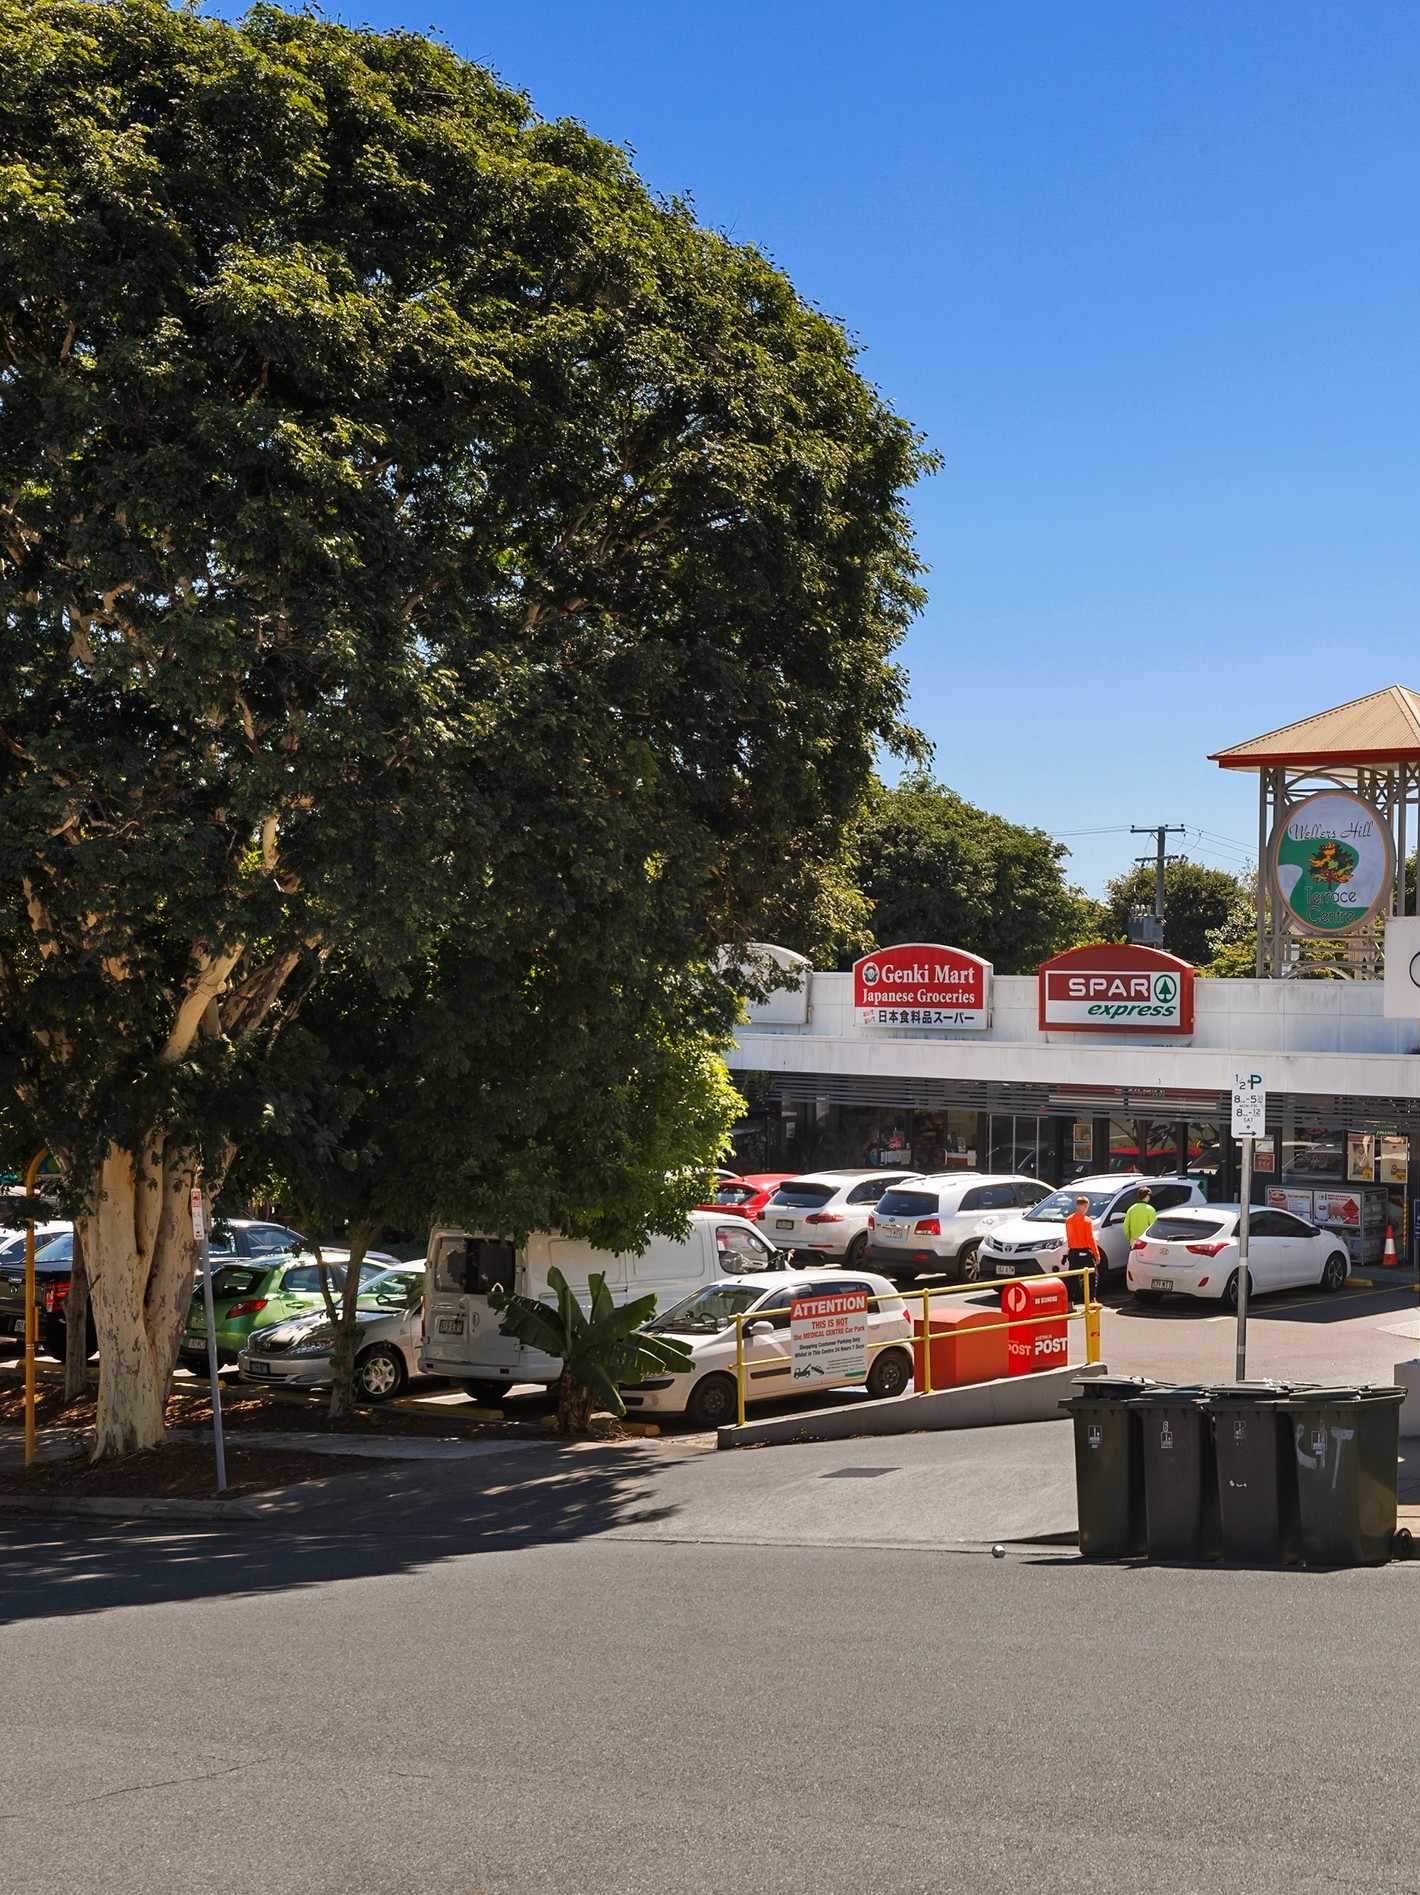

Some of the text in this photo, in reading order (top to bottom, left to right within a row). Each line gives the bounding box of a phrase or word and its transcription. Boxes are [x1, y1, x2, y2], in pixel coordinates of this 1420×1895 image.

[1289, 821, 1374, 840] Wellers Hill
[1305, 886, 1357, 903] Terrace
[1307, 906, 1355, 923] Centre
[881, 964, 975, 984] Genki Mart
[1068, 978, 1149, 997] SPAR
[862, 988, 975, 1005] Japanese Groceries
[879, 1010, 975, 1024] 日本食料品スーパー
[1087, 1003, 1177, 1020] express
[793, 1296, 865, 1317] ATTENTION
[803, 1330, 825, 1339] MEDICAL
[826, 1327, 844, 1336] CENTRE
[854, 1325, 865, 1333] Park
[811, 1317, 849, 1330] THIS IS NOT
[1035, 1337, 1068, 1356] POST
